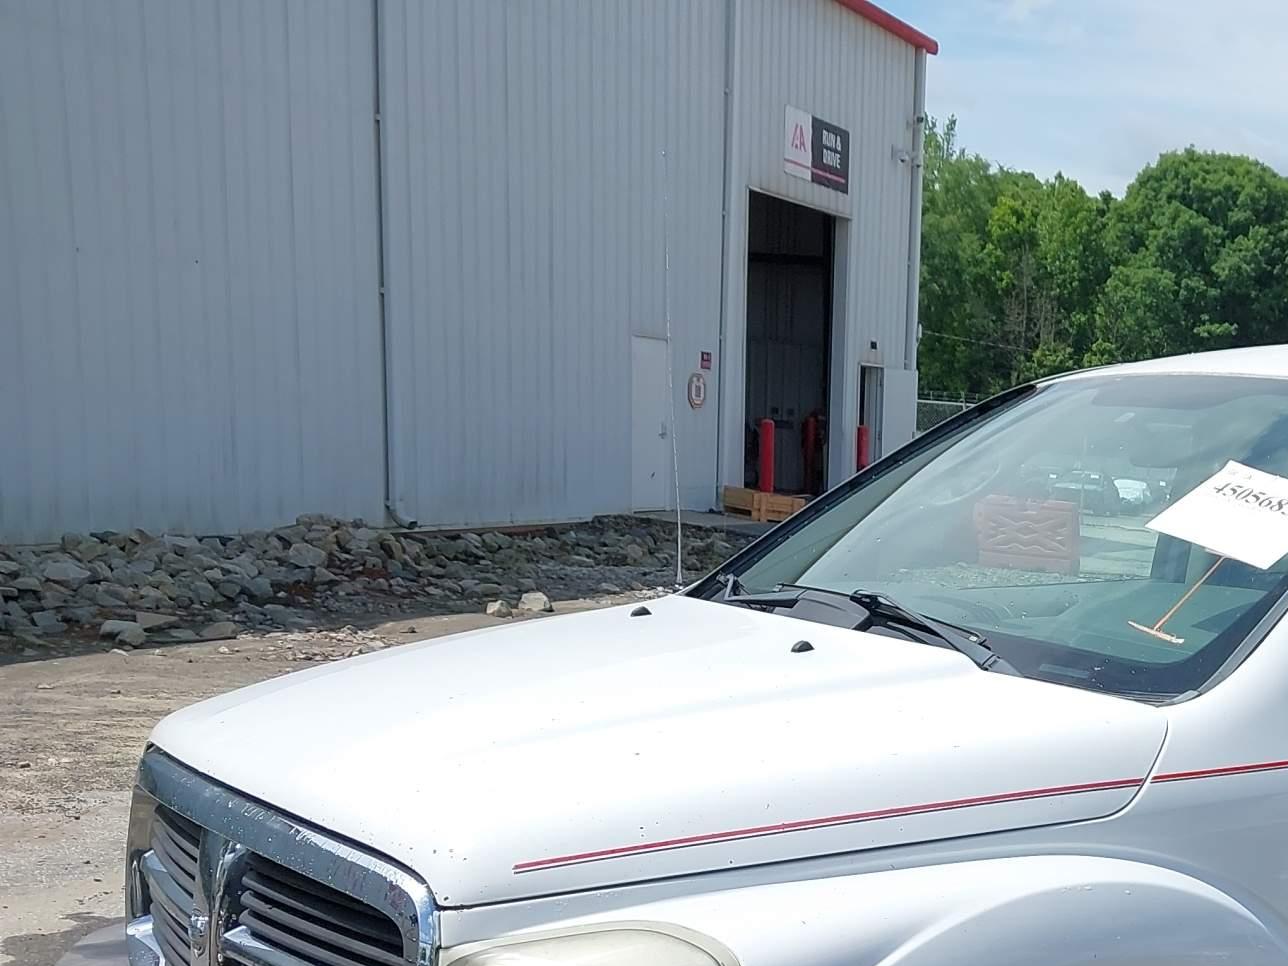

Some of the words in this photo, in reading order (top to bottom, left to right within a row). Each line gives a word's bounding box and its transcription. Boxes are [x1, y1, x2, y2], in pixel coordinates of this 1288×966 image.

[822, 129, 836, 149] RUN
[836, 135, 842, 153] &
[822, 148, 841, 169] DRIVE
